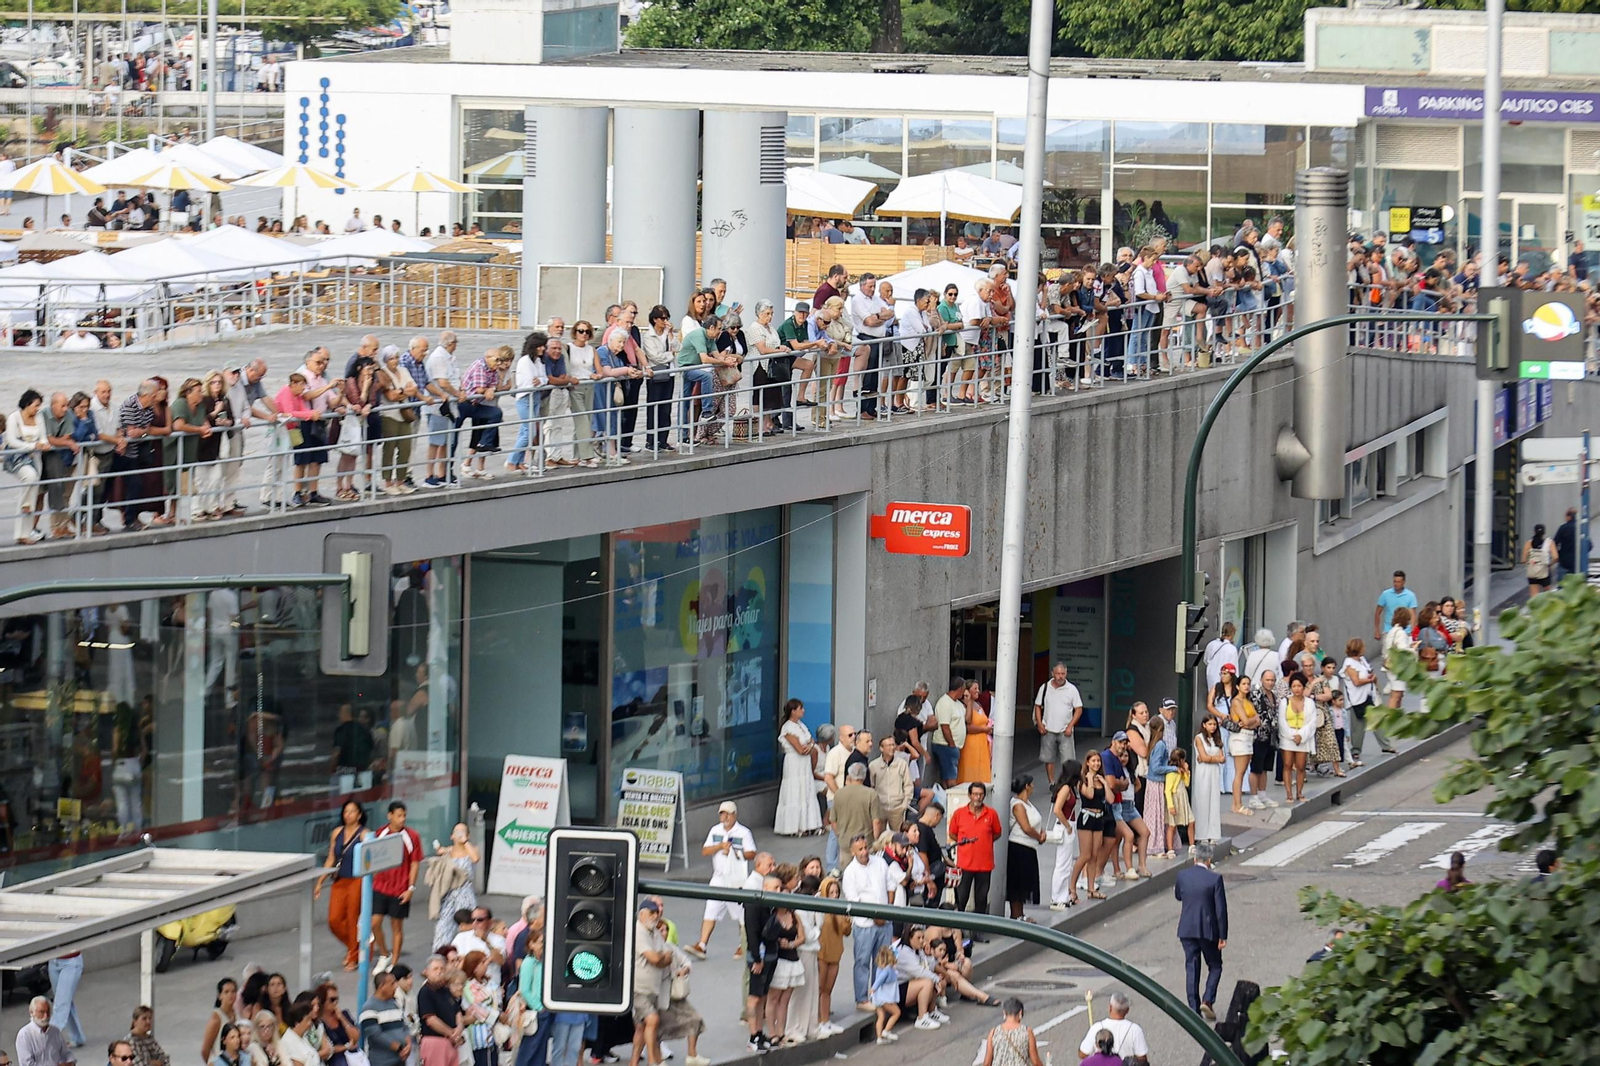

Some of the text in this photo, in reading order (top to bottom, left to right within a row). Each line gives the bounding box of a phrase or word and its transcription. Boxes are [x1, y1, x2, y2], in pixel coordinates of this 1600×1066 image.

[1418, 96, 1484, 112] PARKING
[1499, 98, 1558, 113] AUTICO
[1560, 99, 1594, 115] CIES
[891, 509, 953, 525] merca
[922, 529, 960, 538] express
[712, 613, 734, 636] para
[733, 605, 761, 626] Soñar
[505, 765, 554, 779] merca
[528, 781, 558, 789] express
[624, 791, 642, 801] VENTA
[642, 792, 650, 801] DE
[623, 803, 649, 816] ISLAS
[622, 817, 669, 830] ISLA DE ONS
